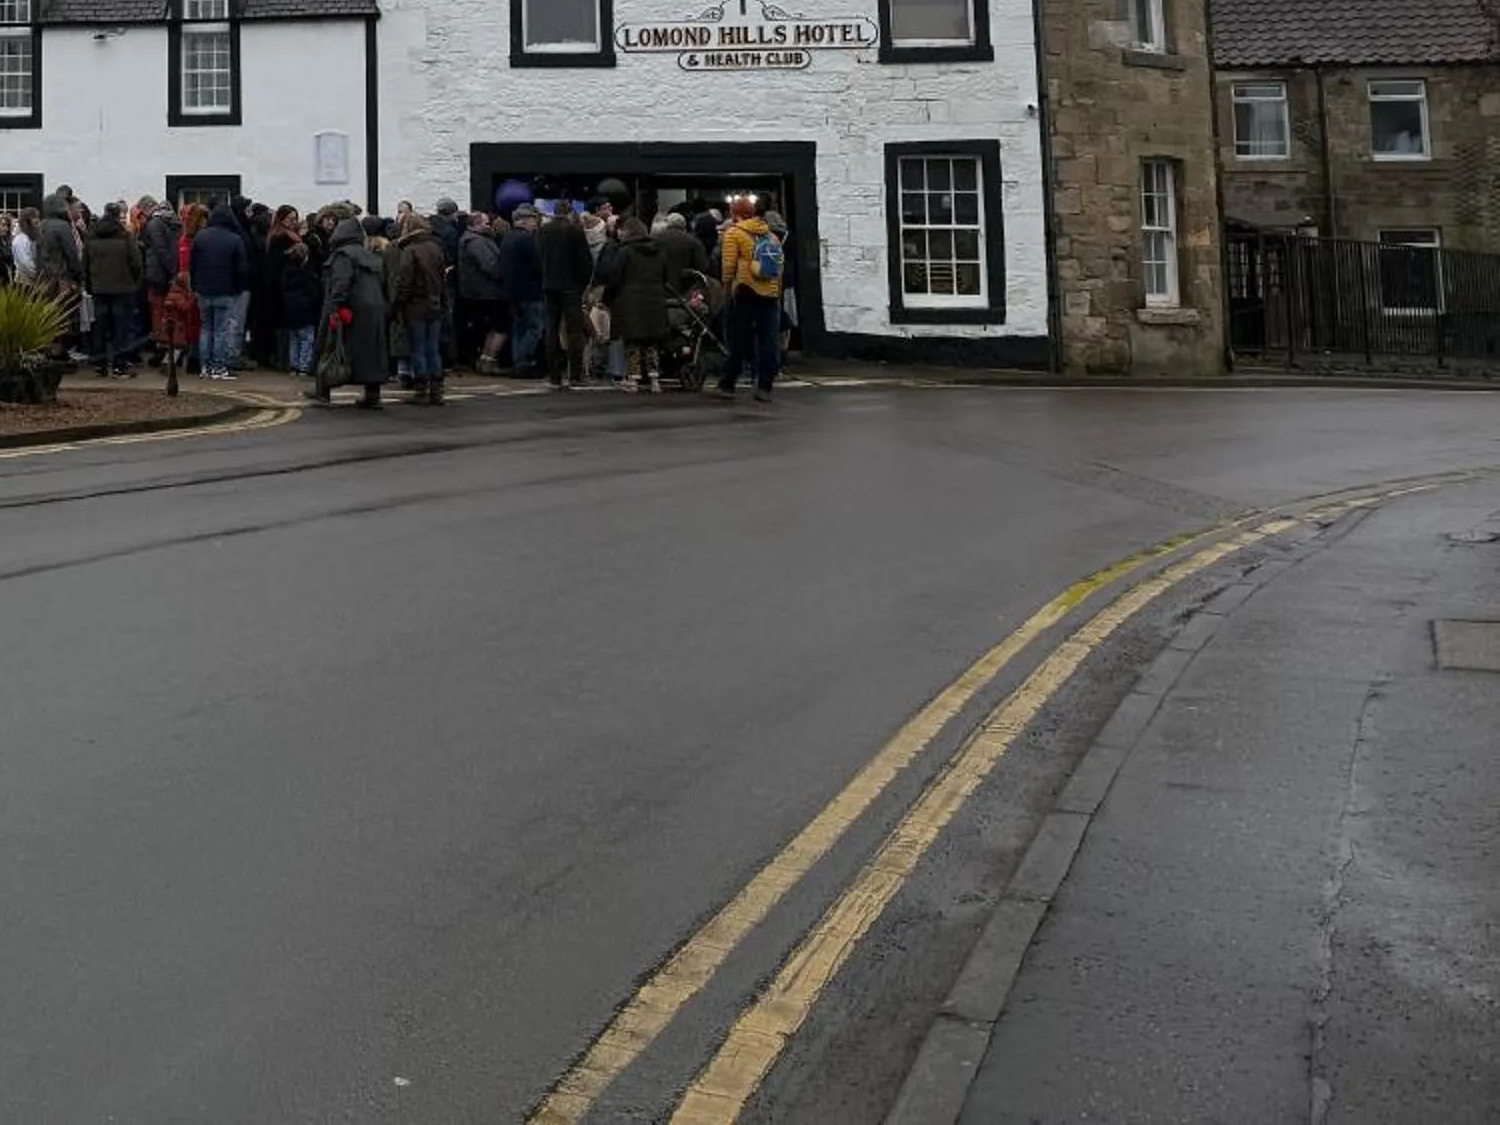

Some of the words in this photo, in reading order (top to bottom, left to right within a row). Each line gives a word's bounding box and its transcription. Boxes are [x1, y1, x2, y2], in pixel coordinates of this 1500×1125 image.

[624, 27, 711, 47] LOMOND
[718, 25, 788, 45] HILLS
[794, 24, 870, 43] HOTEL
[686, 54, 699, 66] &
[704, 52, 762, 66] HEALTH
[765, 51, 803, 65] CLUB
